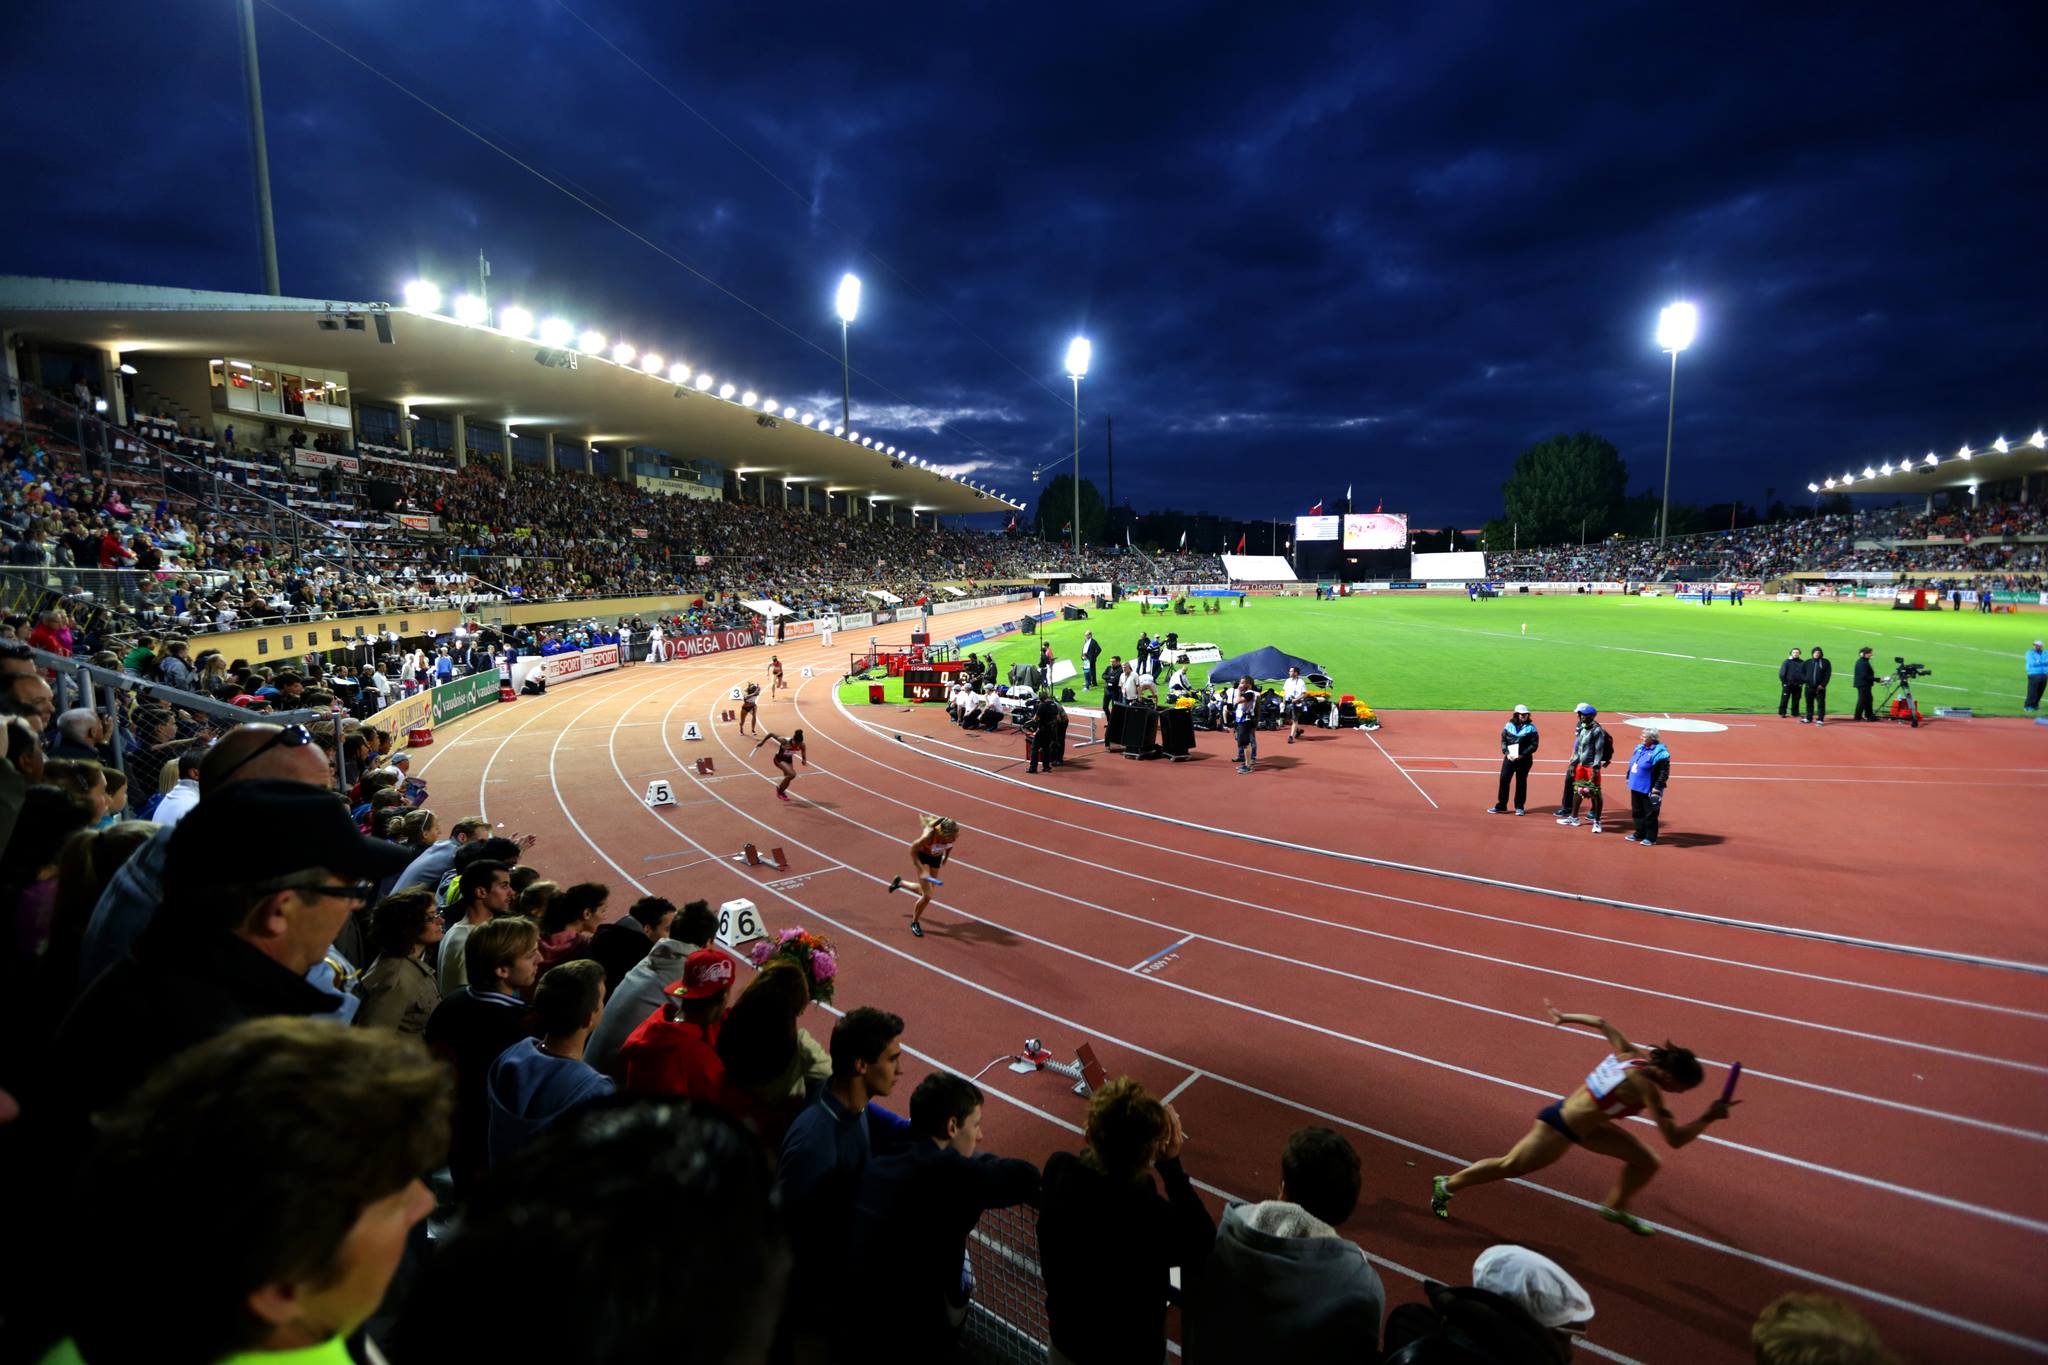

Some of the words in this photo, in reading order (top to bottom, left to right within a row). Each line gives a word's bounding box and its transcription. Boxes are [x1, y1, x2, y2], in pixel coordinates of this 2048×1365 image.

[677, 635, 720, 657] OMEGA
[560, 658, 579, 674] SPORT
[594, 651, 615, 666] SPORT
[733, 689, 740, 698] 3
[687, 726, 696, 737] 4
[656, 786, 668, 801] 5
[720, 910, 730, 936] 6
[738, 910, 755, 936] 6
